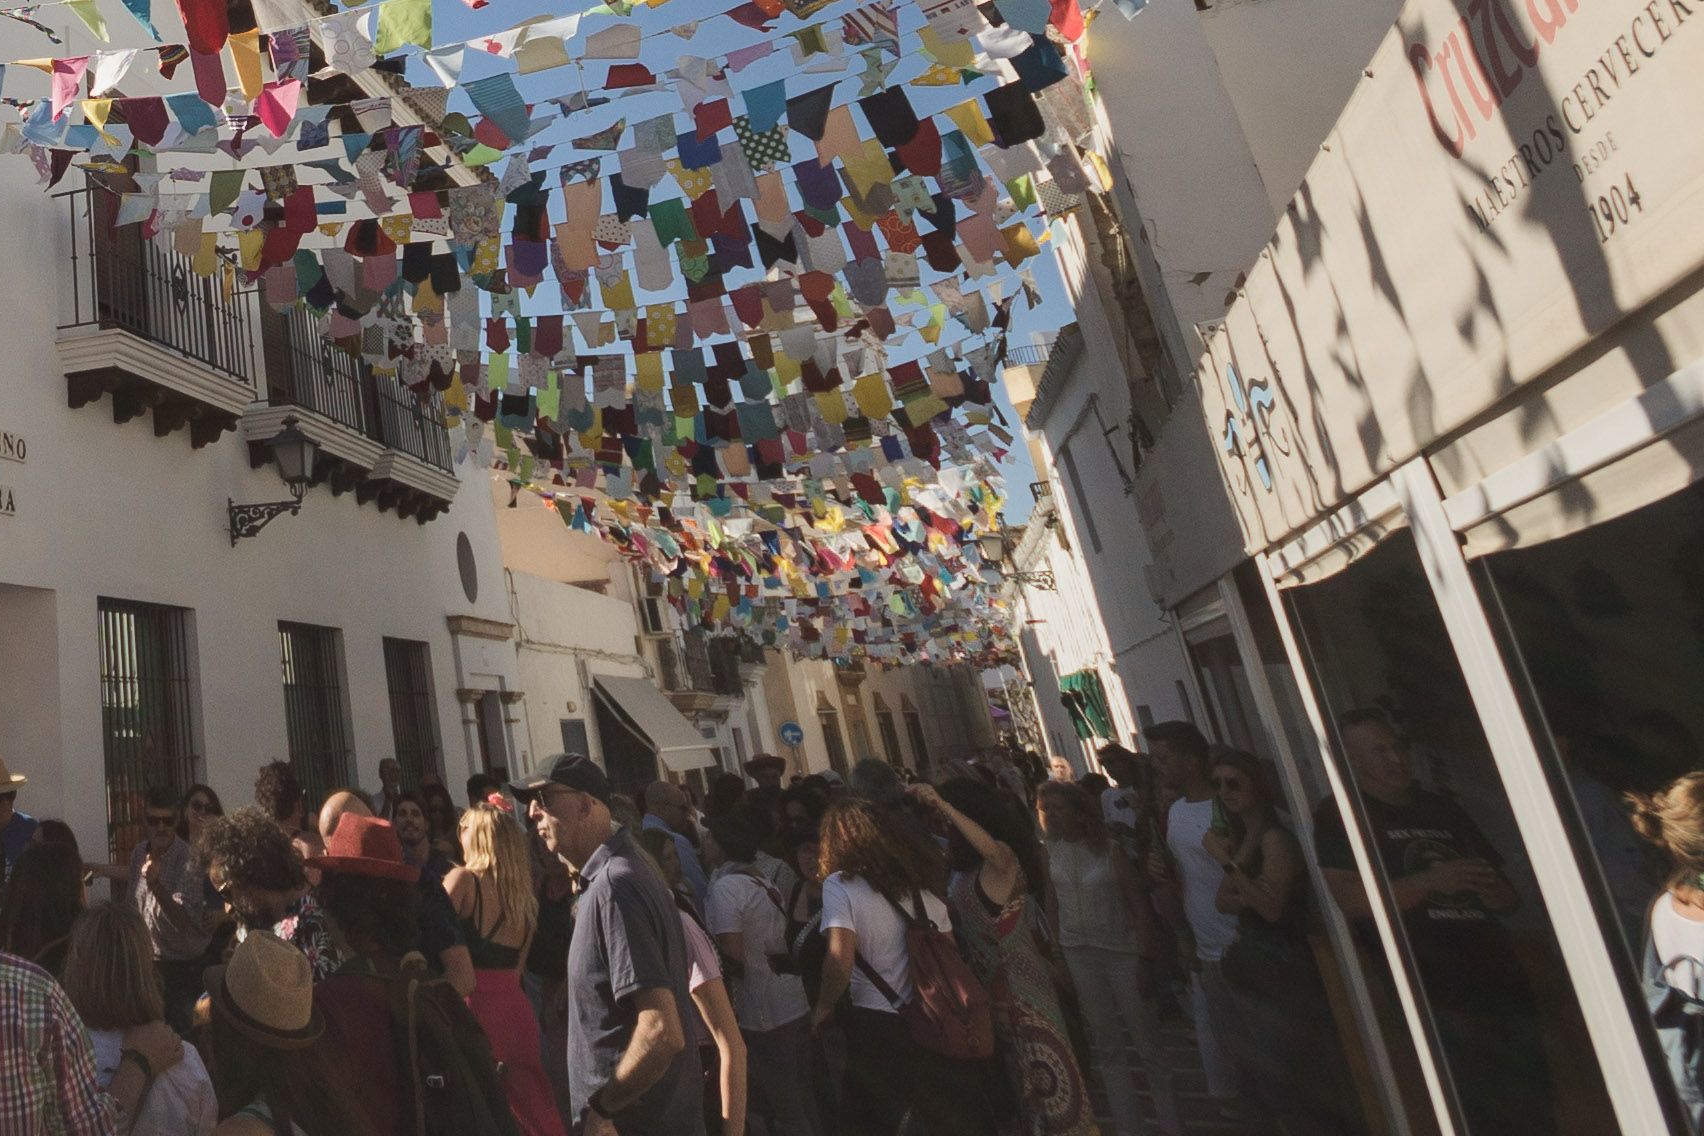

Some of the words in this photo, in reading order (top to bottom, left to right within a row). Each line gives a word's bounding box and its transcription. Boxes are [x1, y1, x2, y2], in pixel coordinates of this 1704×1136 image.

[1467, 114, 1567, 235] MAESTROS
[1573, 131, 1619, 183] DESDE
[1589, 172, 1643, 243] 1904
